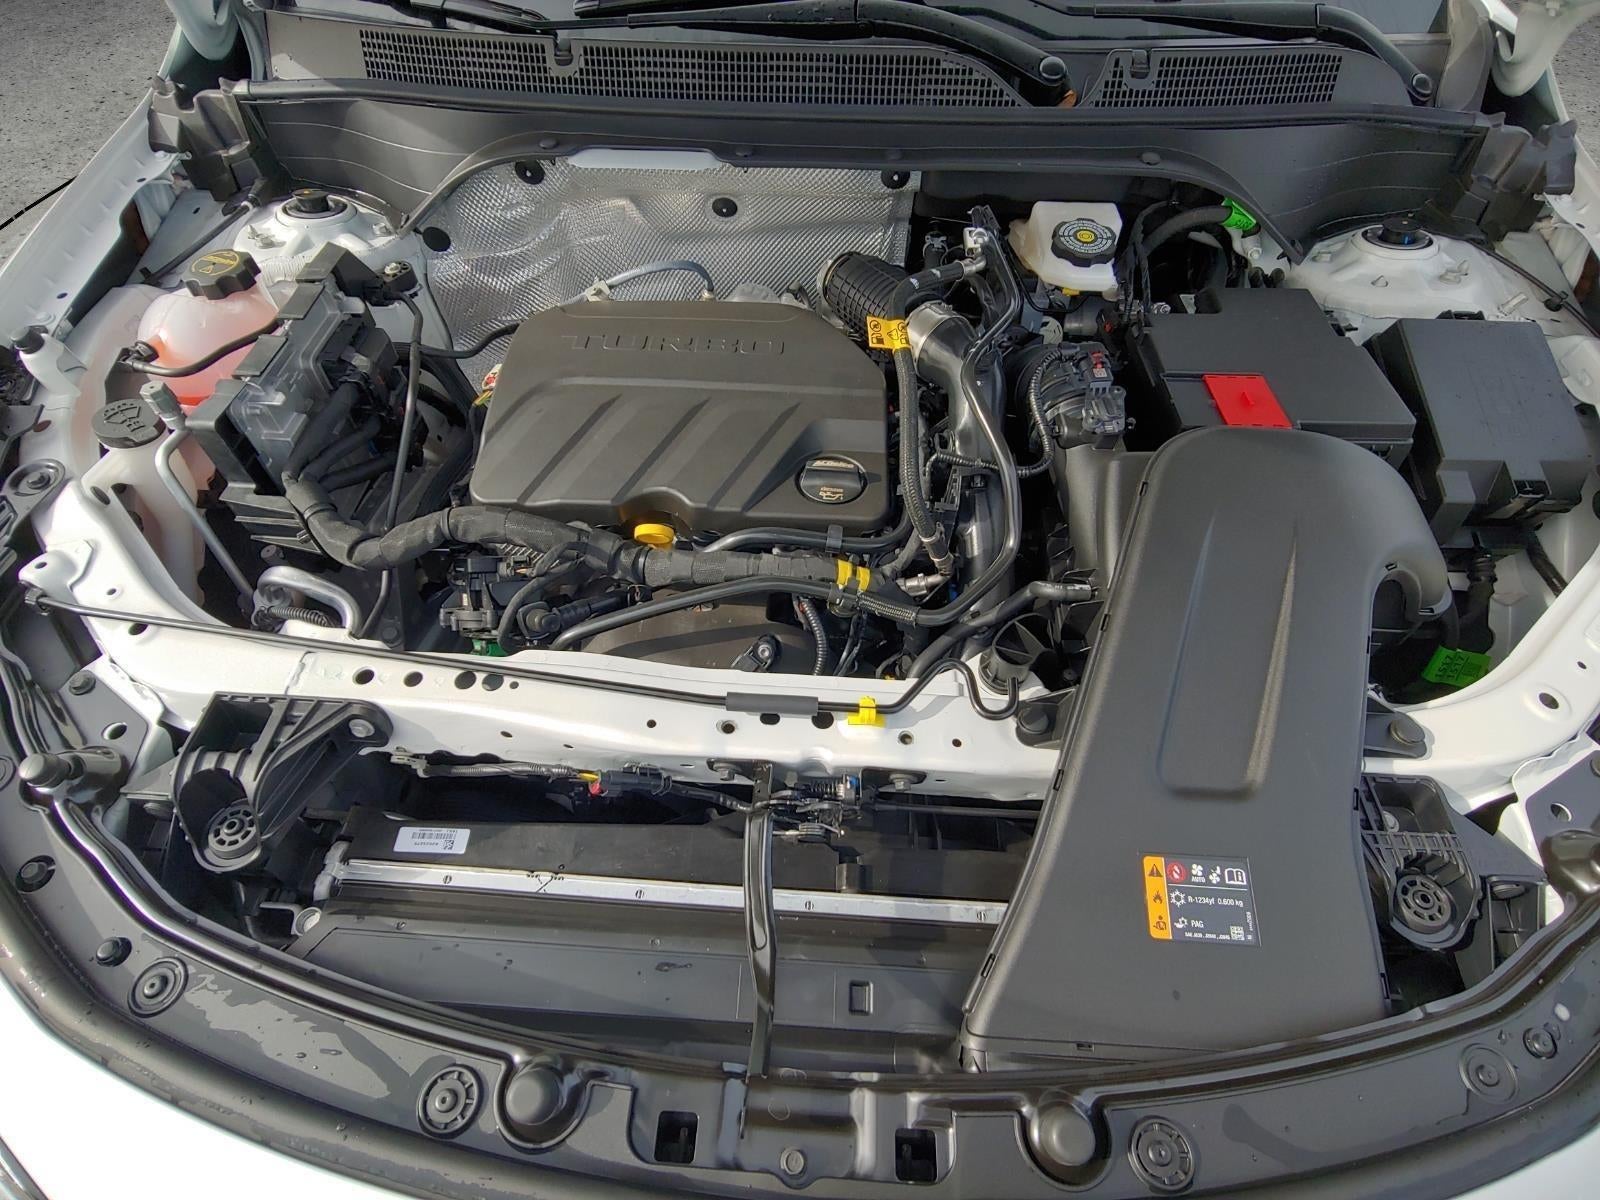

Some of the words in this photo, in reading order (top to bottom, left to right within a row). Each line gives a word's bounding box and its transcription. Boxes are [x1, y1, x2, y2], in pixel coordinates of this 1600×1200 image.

[560, 334, 786, 355] TURBO
[1187, 896, 1215, 906] R-1234yf
[1217, 898, 1235, 906] 0.600
[1235, 899, 1244, 908] kg
[1191, 919, 1204, 928] PAG
